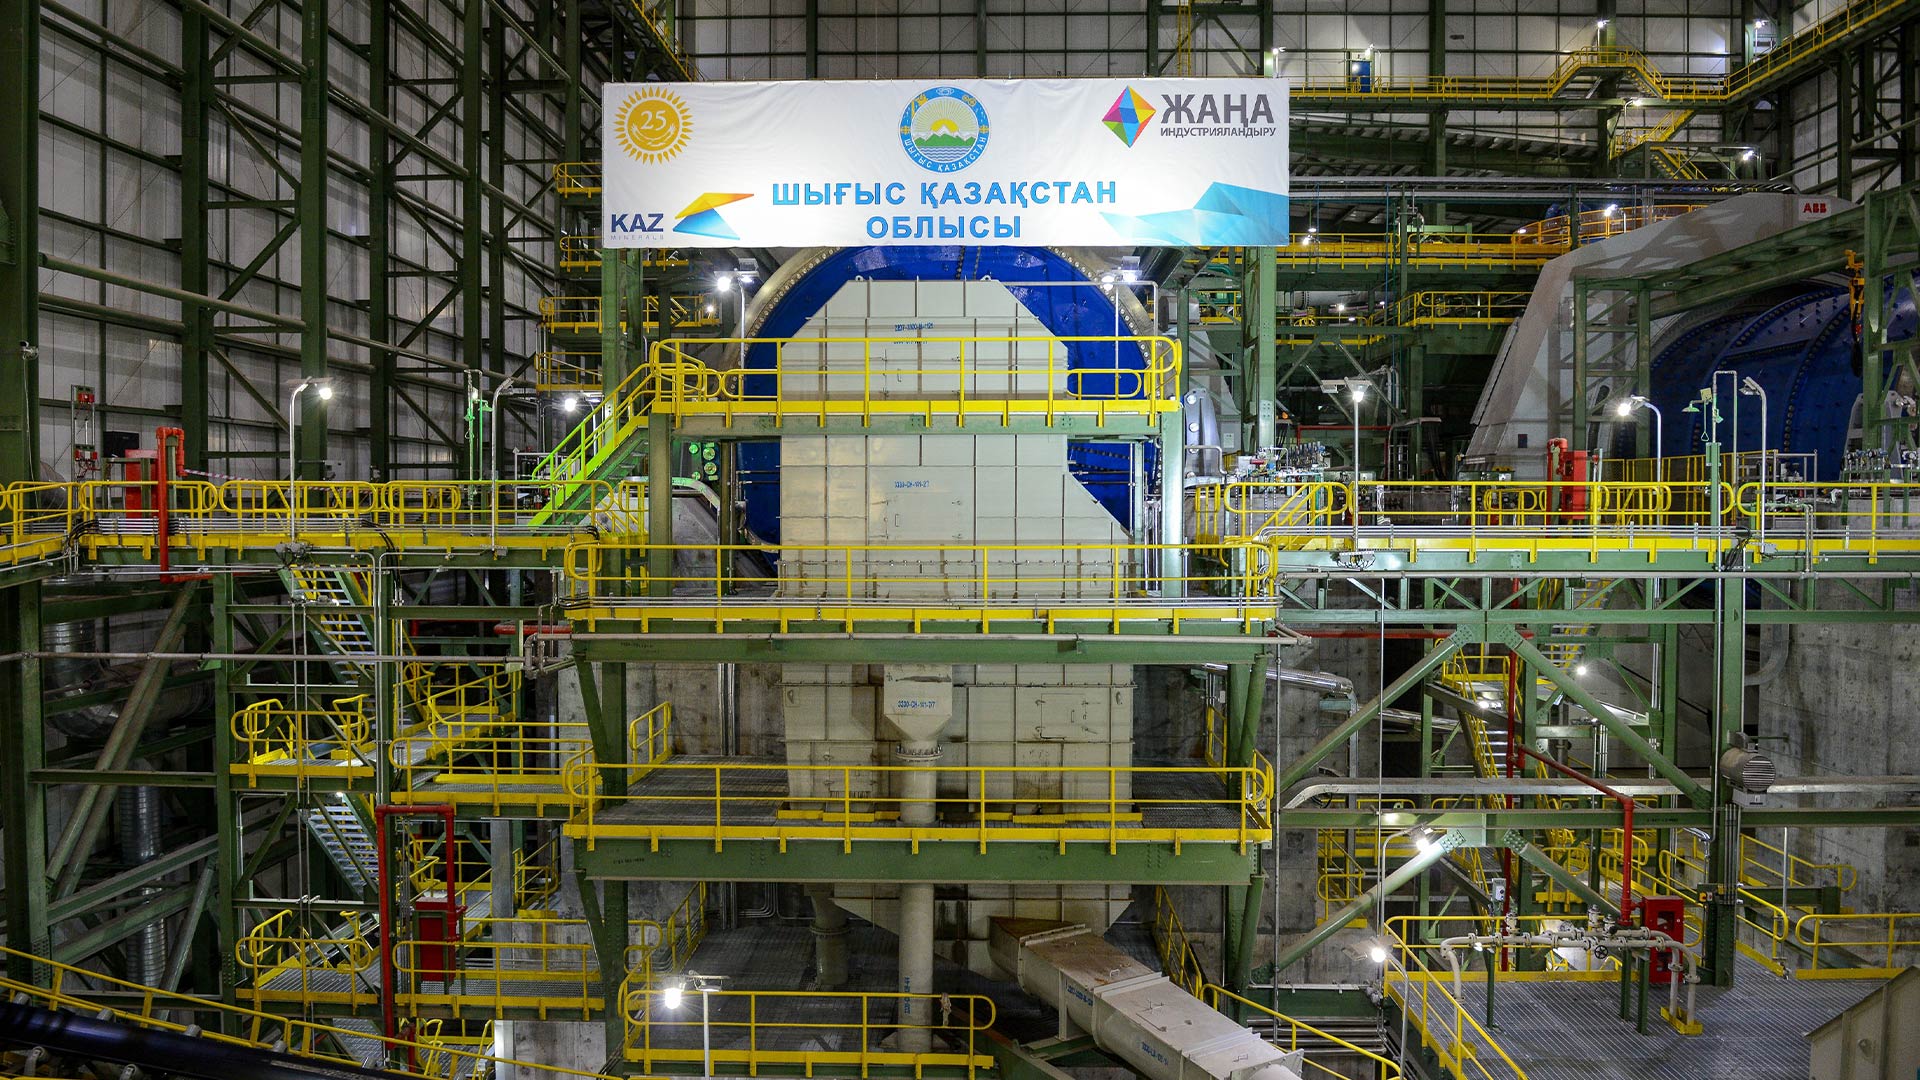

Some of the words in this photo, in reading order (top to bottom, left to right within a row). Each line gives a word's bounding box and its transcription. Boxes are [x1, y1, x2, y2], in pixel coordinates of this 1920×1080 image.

[641, 109, 667, 131] 25
[1161, 94, 1275, 128] ЖАҢА
[1160, 127, 1277, 139] ИНДУСТРИЯЛАНДЫРУ
[772, 182, 906, 206] ШЫҒЫС
[920, 181, 1116, 209] ҚАЗАҚСТАН
[1803, 202, 1827, 213] ABB
[611, 213, 664, 233] KAZ
[866, 215, 1021, 239] ОБЛЫСЫ
